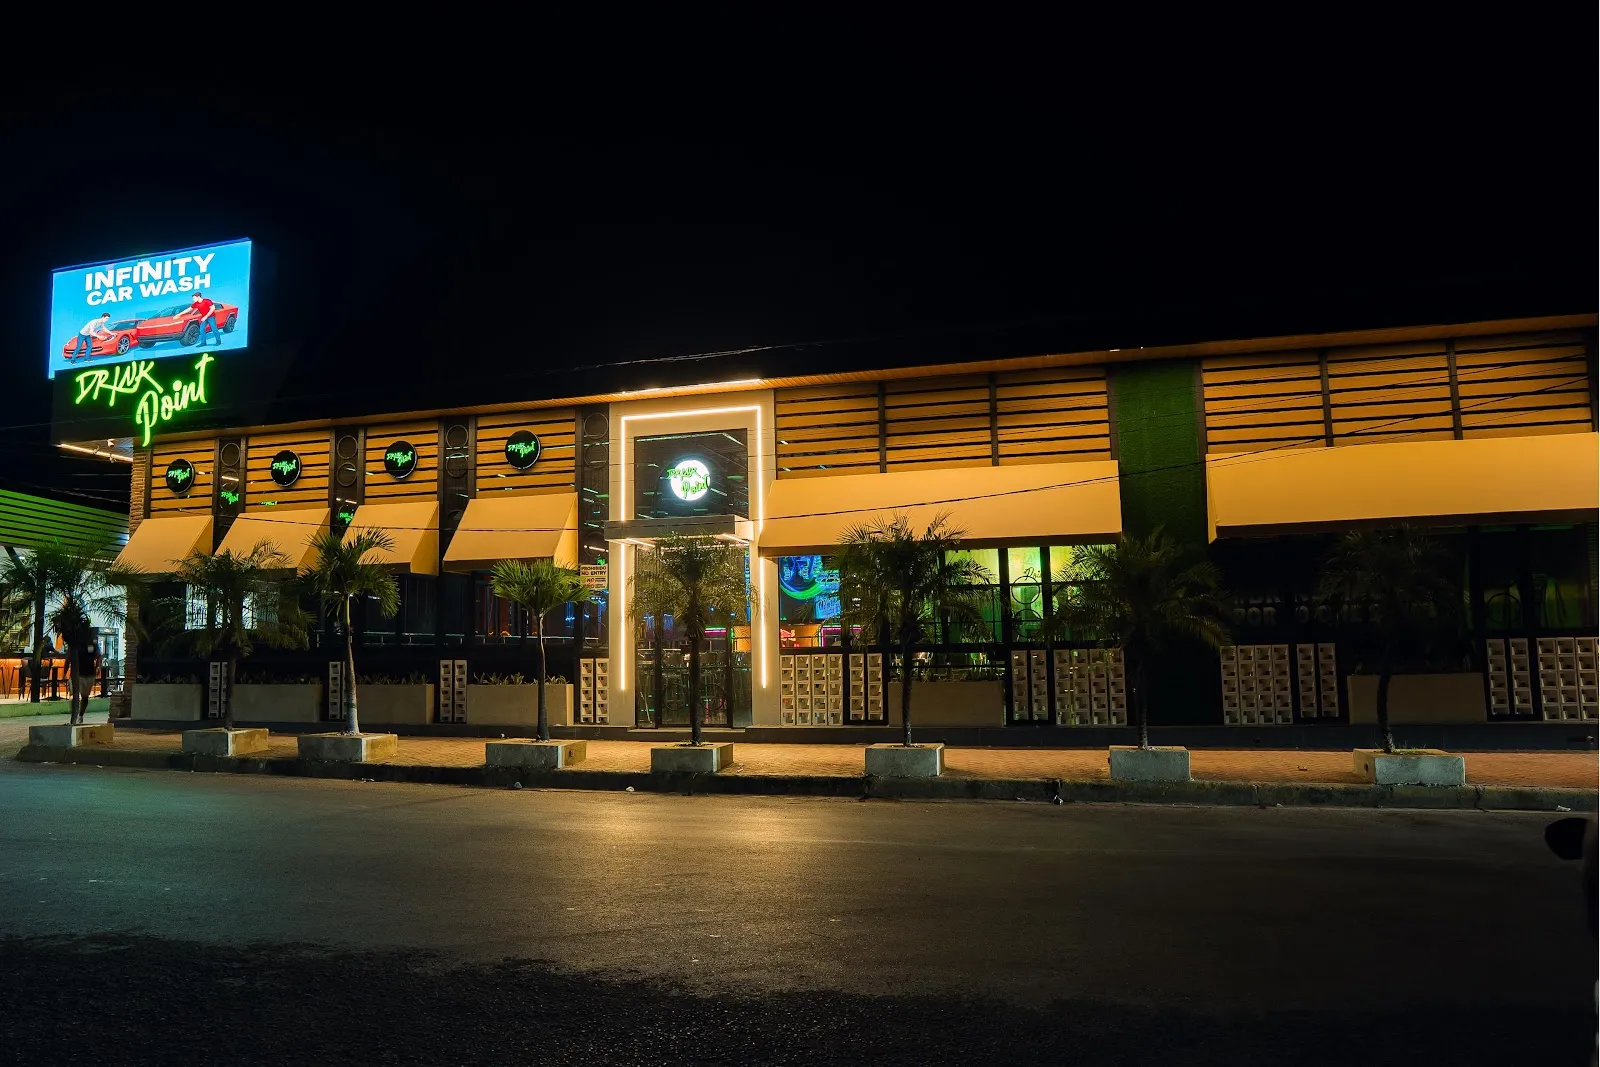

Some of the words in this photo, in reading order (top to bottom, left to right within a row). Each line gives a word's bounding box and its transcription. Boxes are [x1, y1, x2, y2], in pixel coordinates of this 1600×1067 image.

[85, 253, 215, 292] INFINITY
[86, 286, 133, 306] CAR
[139, 274, 211, 299] WASH
[75, 361, 164, 407] DRINK
[136, 353, 214, 447] Point
